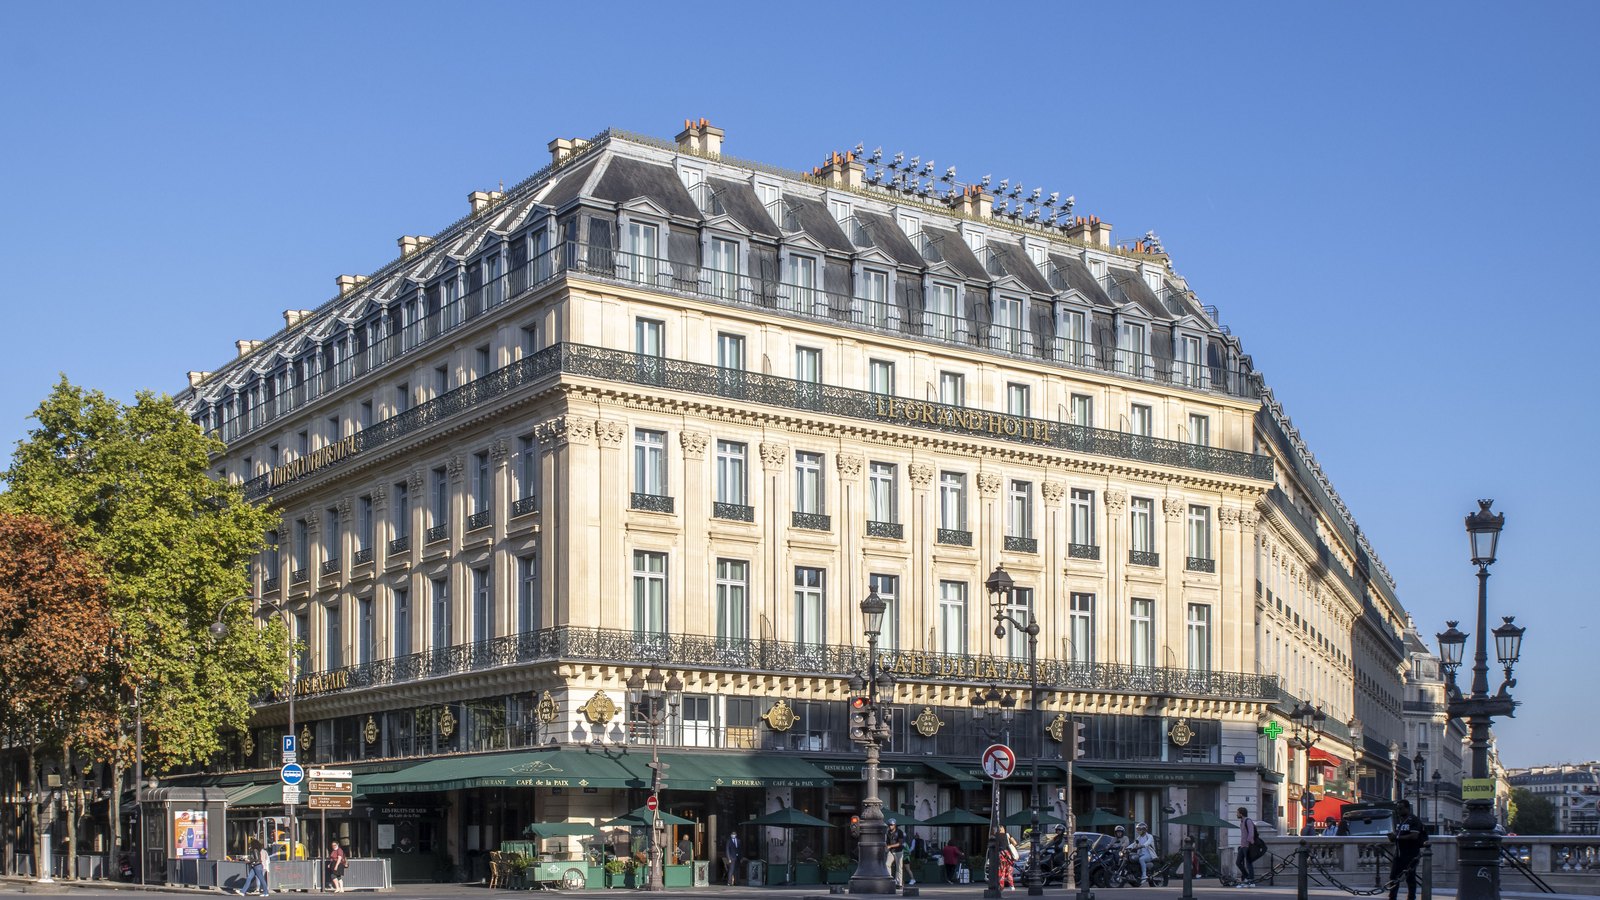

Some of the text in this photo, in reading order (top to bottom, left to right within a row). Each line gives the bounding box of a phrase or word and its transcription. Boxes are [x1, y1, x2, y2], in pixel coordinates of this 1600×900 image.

[876, 398, 1051, 442] LE GRAND HOTEL
[940, 656, 966, 677] DE
[973, 658, 999, 679] LA
[1006, 661, 1048, 682] PAX
[286, 739, 292, 750] P
[516, 778, 533, 786] CAFÉ
[1463, 784, 1490, 792] DÉVIATION
